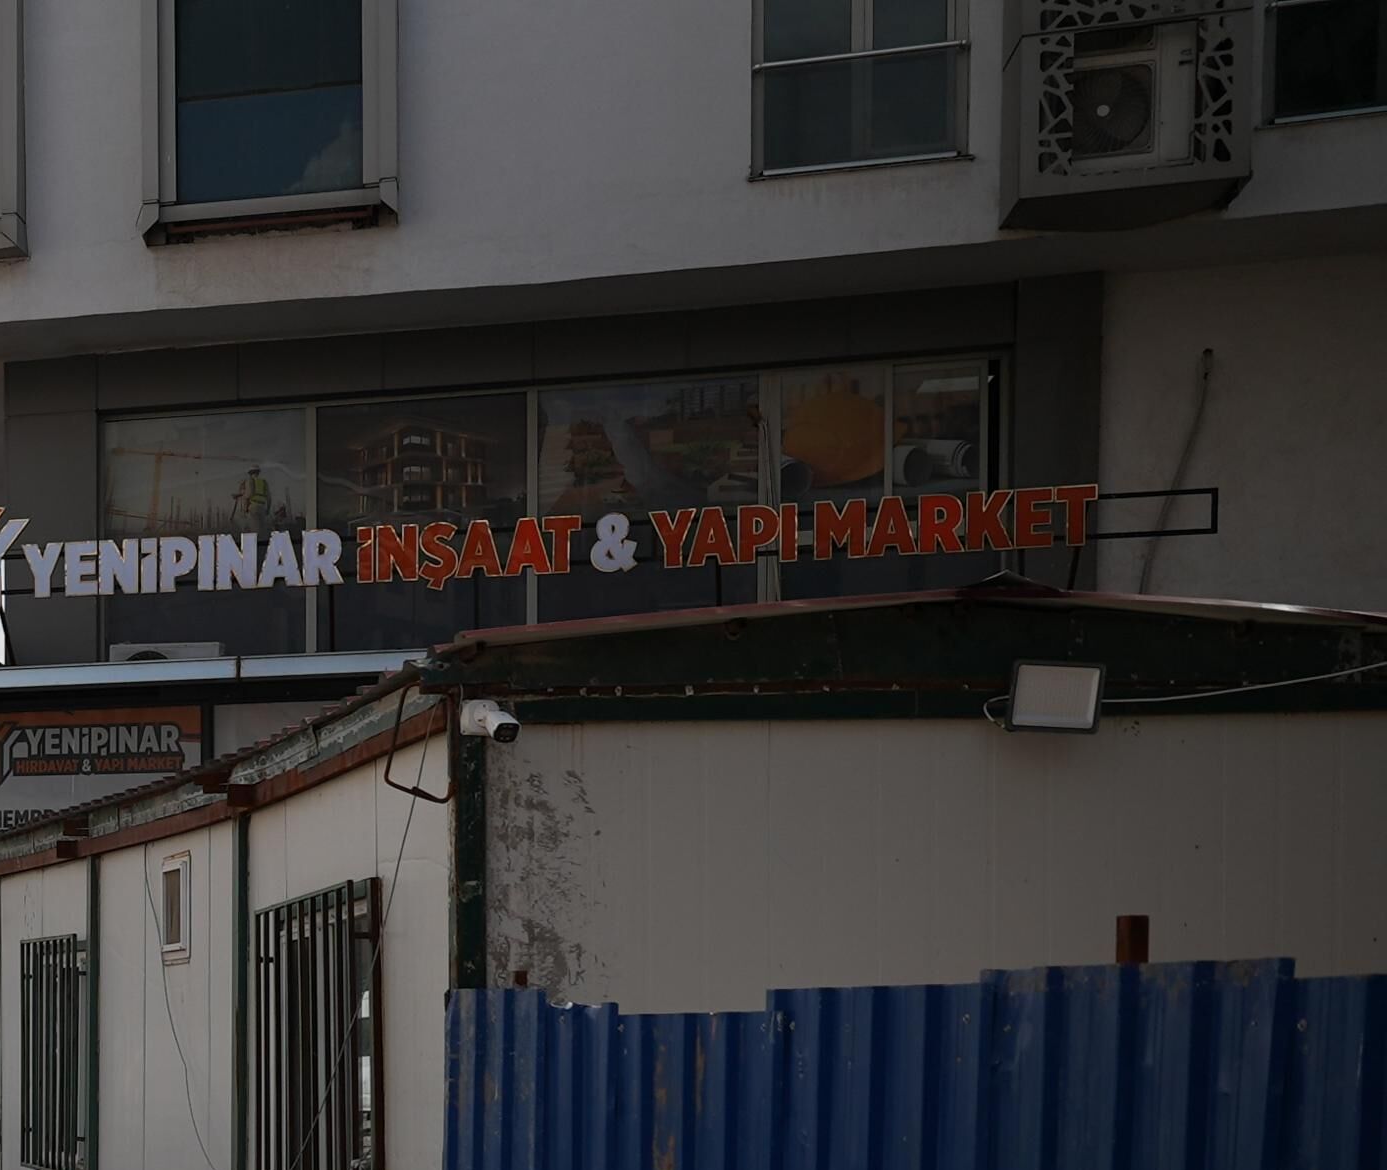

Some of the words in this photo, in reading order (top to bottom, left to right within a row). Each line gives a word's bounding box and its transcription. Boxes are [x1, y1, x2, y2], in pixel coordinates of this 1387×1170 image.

[357, 515, 581, 590] İNŞAAT
[590, 512, 638, 573] &
[649, 502, 799, 568] YAPI
[814, 484, 1098, 561] MARKET
[15, 758, 79, 774] HIRDAVAT
[81, 758, 92, 773] &
[94, 757, 124, 772] YAPI
[127, 756, 183, 772] MARKET
